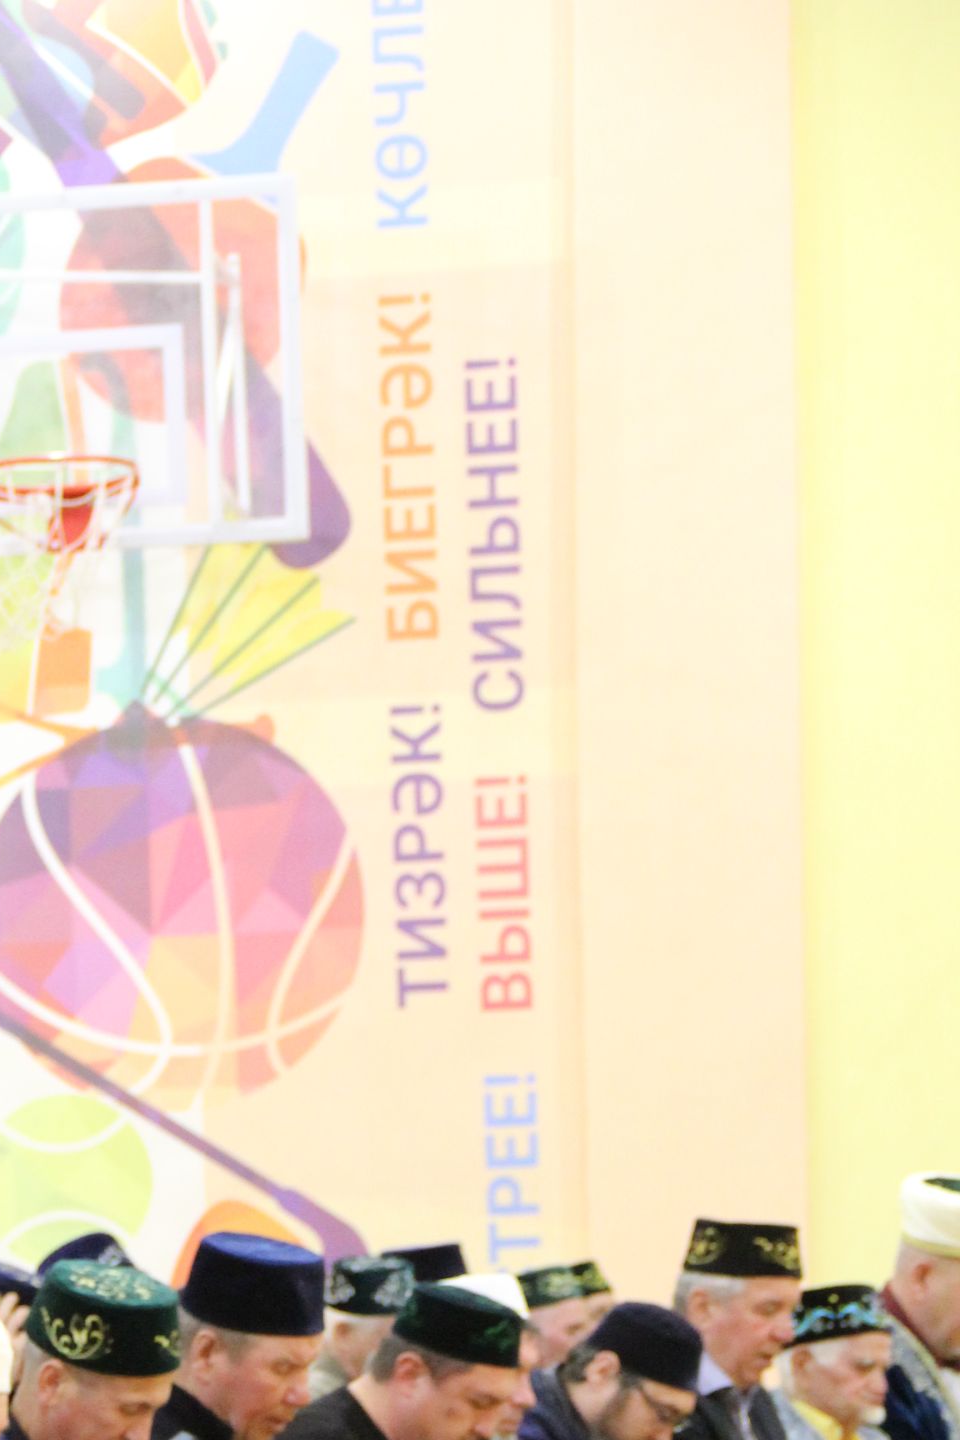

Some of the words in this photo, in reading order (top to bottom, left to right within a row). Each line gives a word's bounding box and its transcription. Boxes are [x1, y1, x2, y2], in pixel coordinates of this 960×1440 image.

[378, 293, 439, 641] БИЕГРӘК!
[464, 357, 525, 711] СИЛЬНЕЕ!
[389, 704, 448, 1008] ТИЗРӘК!
[474, 775, 533, 1012] ВЫШЕ!
[483, 1073, 541, 1275] ТРЕЕ!
